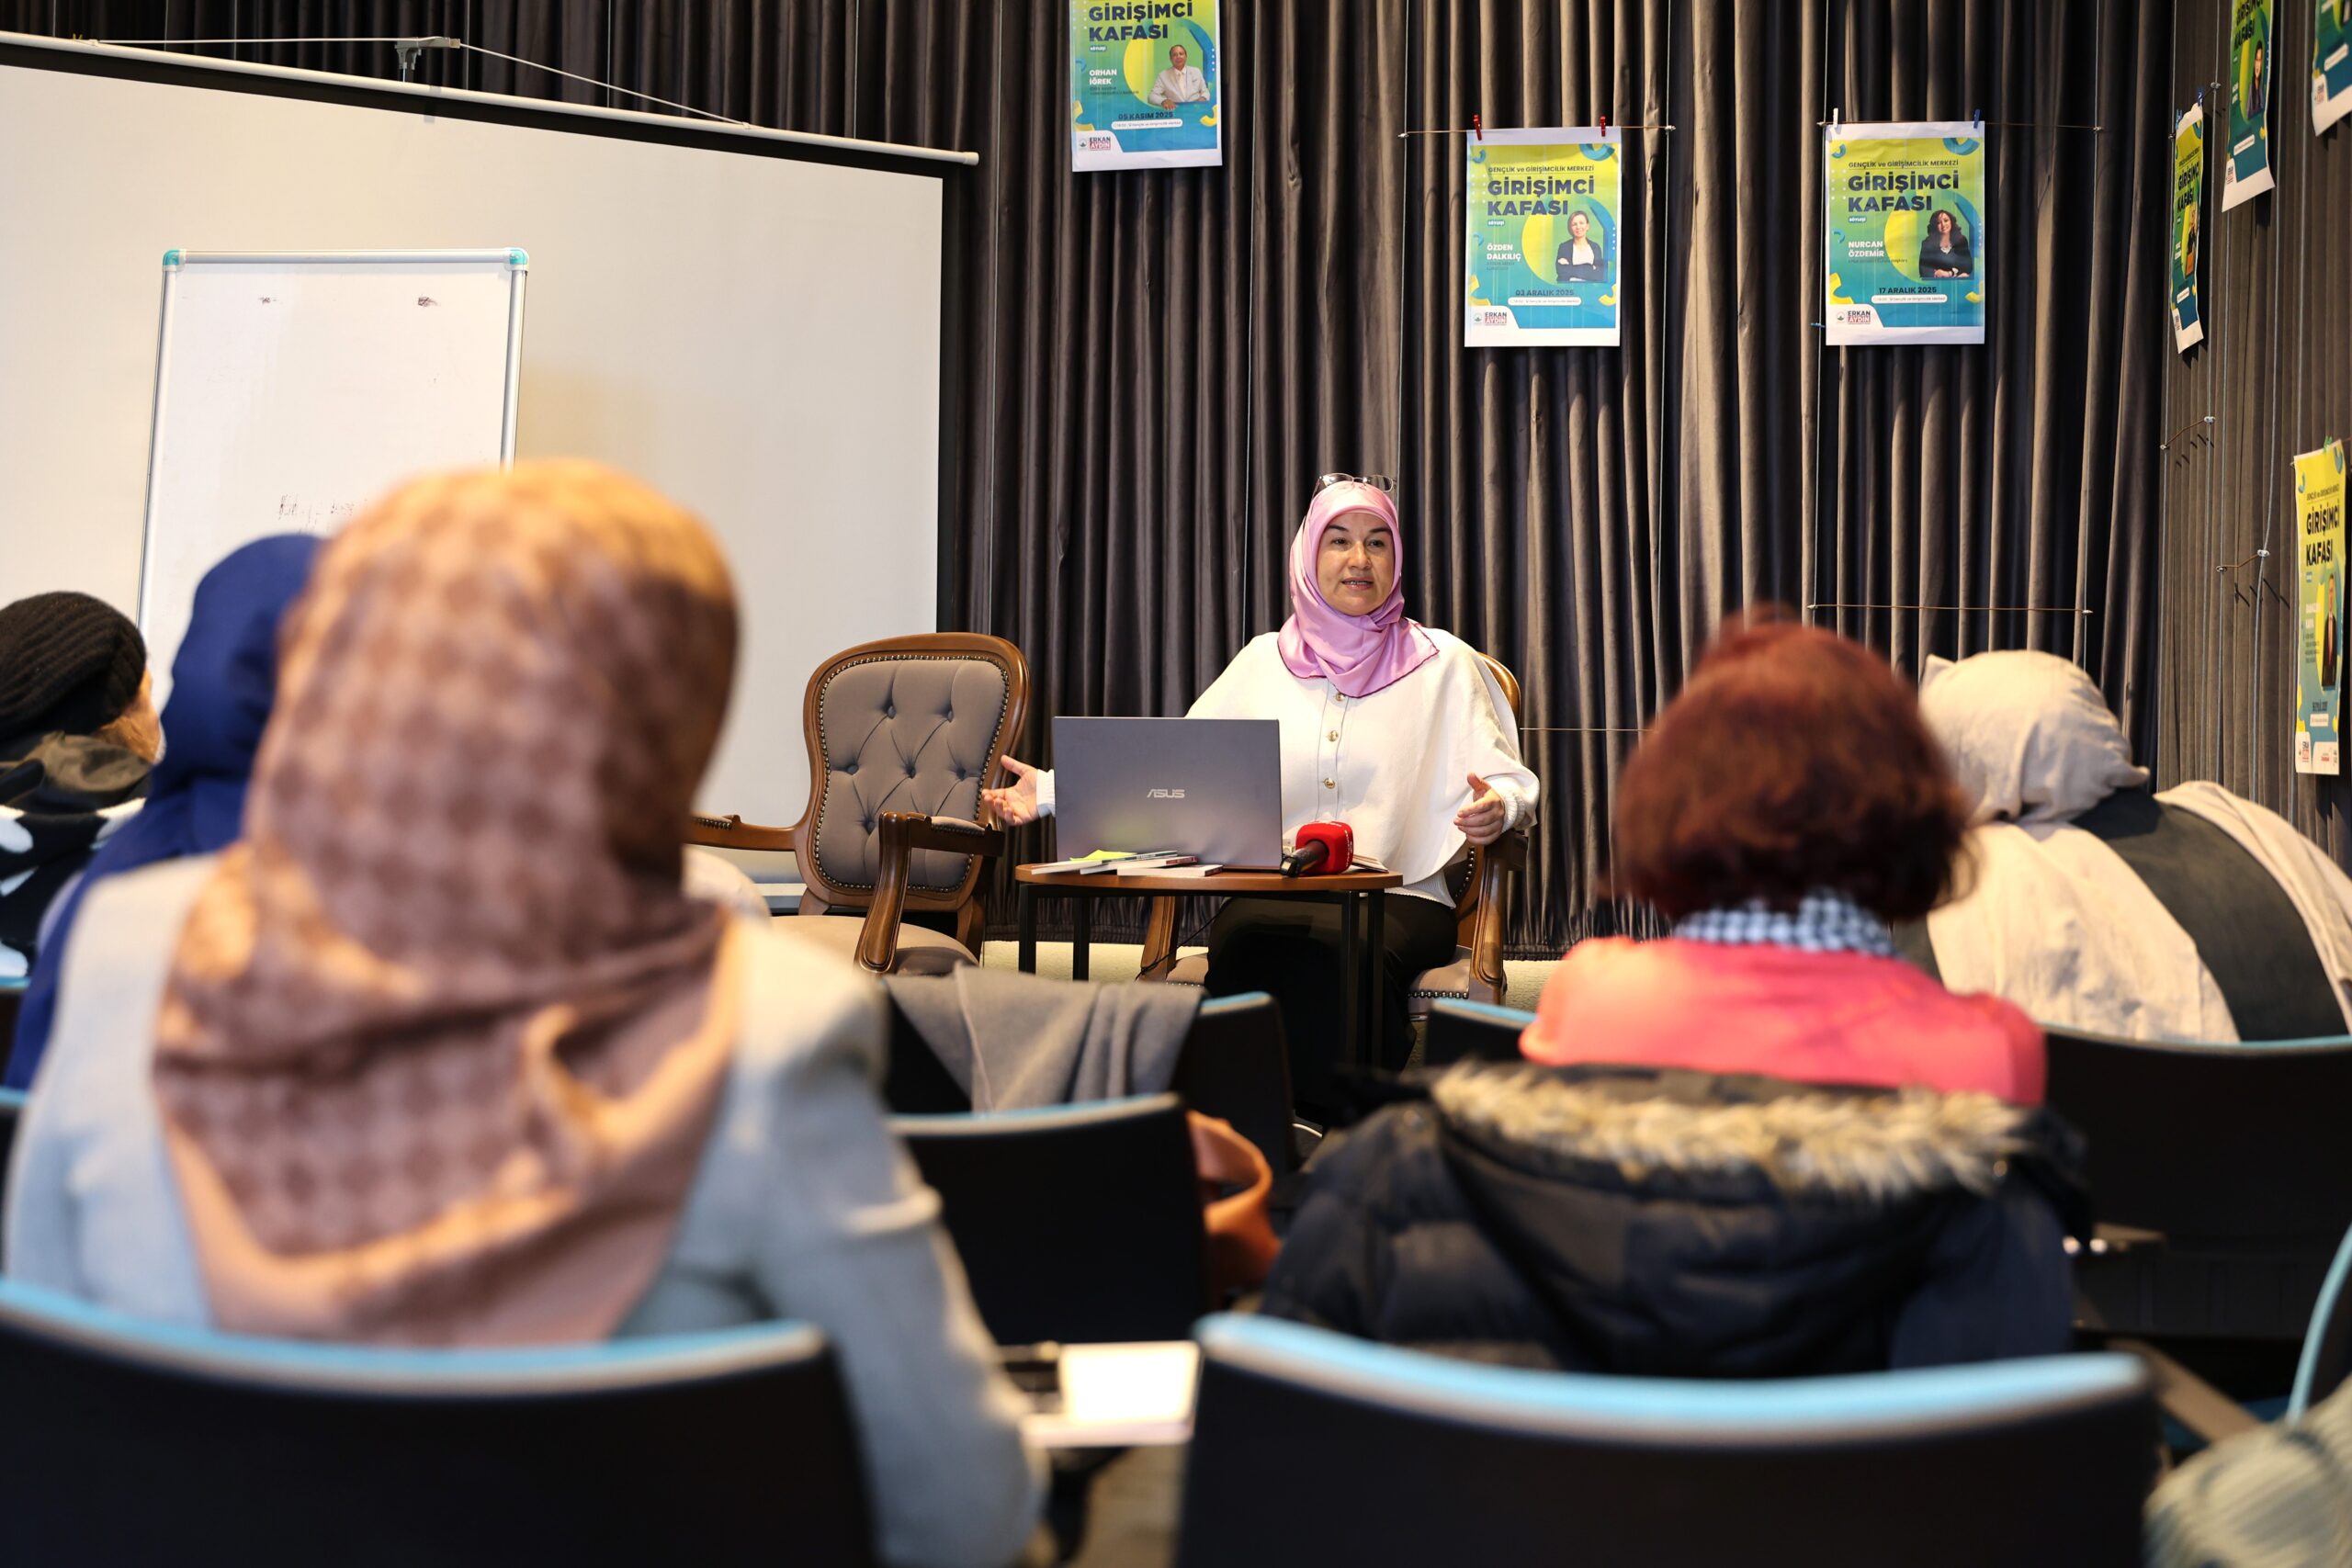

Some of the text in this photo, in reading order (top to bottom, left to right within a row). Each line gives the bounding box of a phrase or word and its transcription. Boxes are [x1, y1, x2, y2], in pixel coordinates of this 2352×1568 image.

[1089, 0, 1193, 23] GİRİŞİMCİ
[1089, 24, 1168, 41] KAFASI
[1526, 165, 1566, 174] GİRİŞİMCİLİK
[1849, 161, 1876, 169] GENÇLİK
[1887, 161, 1929, 169] GİRİŞİMCİLİK
[1487, 175, 1594, 197] GİRİŞİMCİ
[1848, 170, 1959, 194] GİRİŞİMCİ
[1487, 200, 1568, 216] KAFASI
[1849, 196, 1932, 212] KAFASI
[1487, 243, 1513, 251] ÖZDEN
[1849, 249, 1884, 257] ÖZDEMİR
[1487, 253, 1521, 262] DALKILIÇ
[2306, 498, 2340, 536] GİRİŞİMCİ
[2306, 538, 2334, 567] KAFASI
[1147, 788, 1185, 798] ASUS
